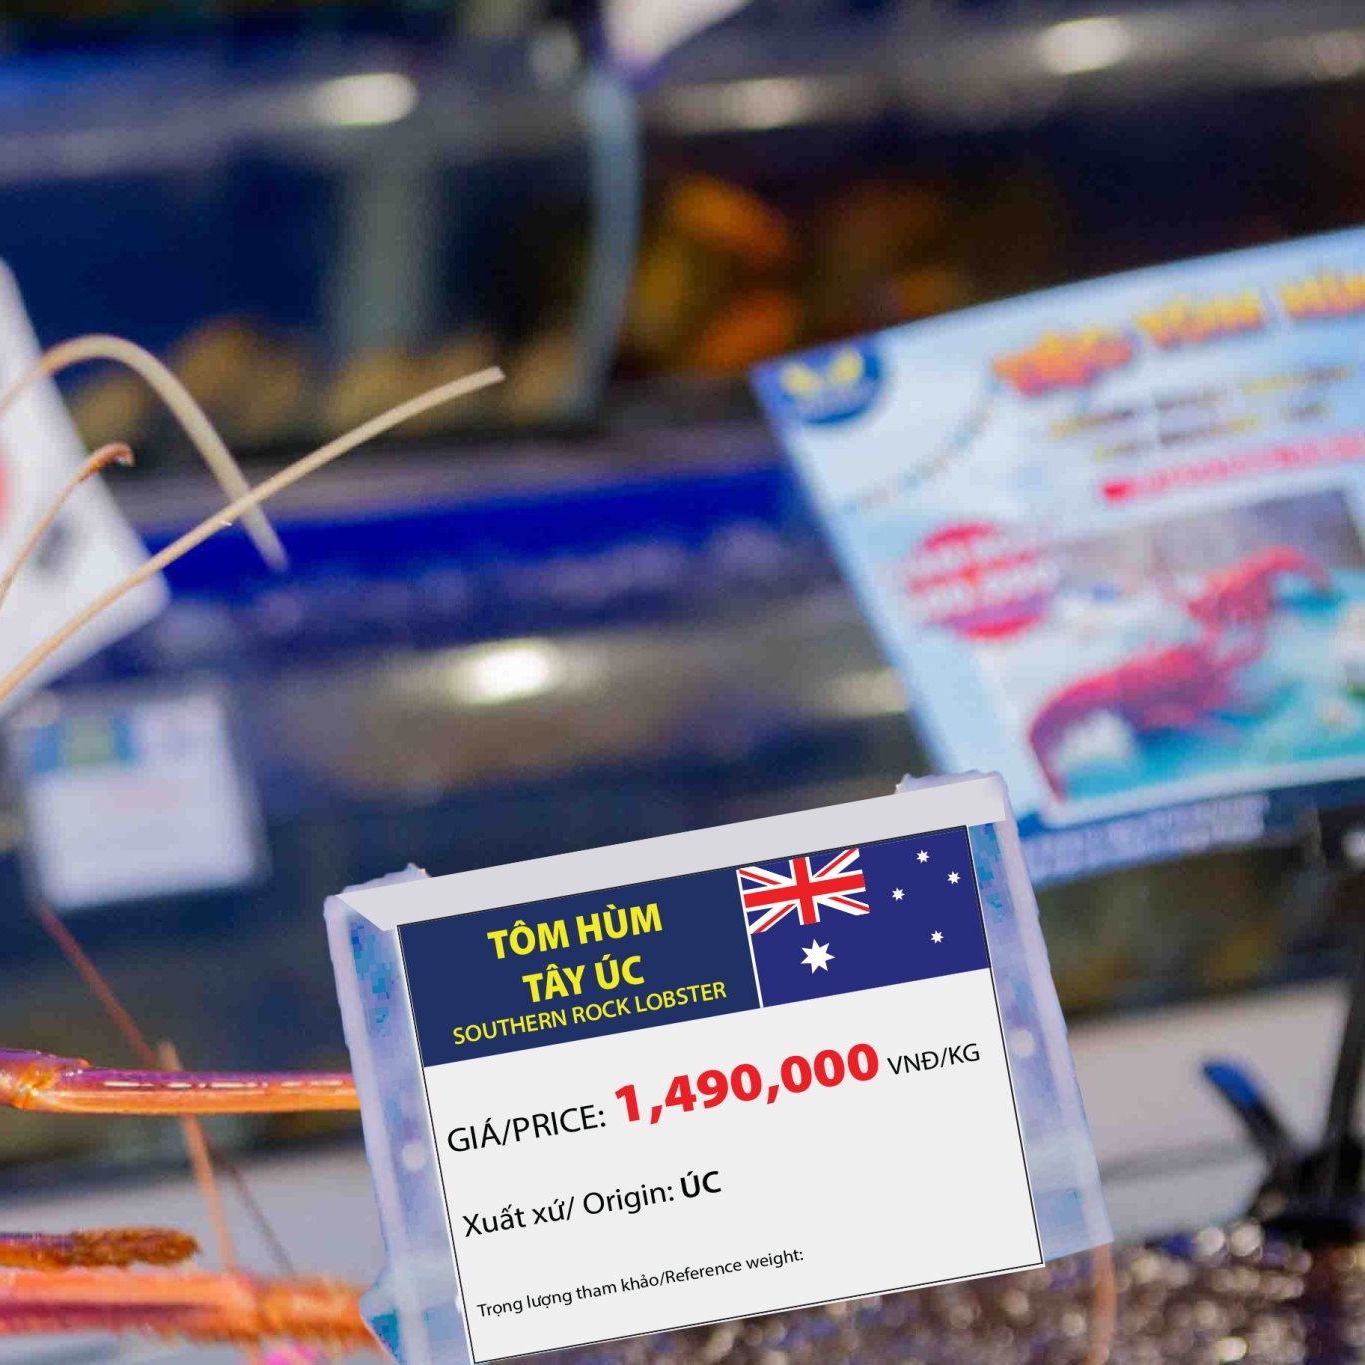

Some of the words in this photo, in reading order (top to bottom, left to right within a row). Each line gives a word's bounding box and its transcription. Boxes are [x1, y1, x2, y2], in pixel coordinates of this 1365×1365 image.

[486, 919, 570, 960] TÔM
[575, 903, 663, 945] HÙM
[521, 963, 585, 1003] TÂY
[594, 953, 645, 990] ÚC
[453, 1009, 567, 1045] SOUTHERN
[571, 997, 631, 1023] ROCK
[634, 981, 726, 1013] LOBSTER
[447, 1104, 606, 1152] GIÁ/PRICE:
[614, 1043, 879, 1125] 1,490,000
[886, 1042, 980, 1075] VNĐ/KG
[462, 1203, 527, 1238] Xuất
[531, 1196, 575, 1225] xứ/
[583, 1184, 675, 1215] Origin:
[680, 1170, 722, 1199] ÚC
[476, 1300, 523, 1317] Trọng
[526, 1291, 573, 1309] lượng
[575, 1283, 617, 1300] tham
[620, 1261, 742, 1292] khảo/Reference
[745, 1249, 804, 1270] weight:
